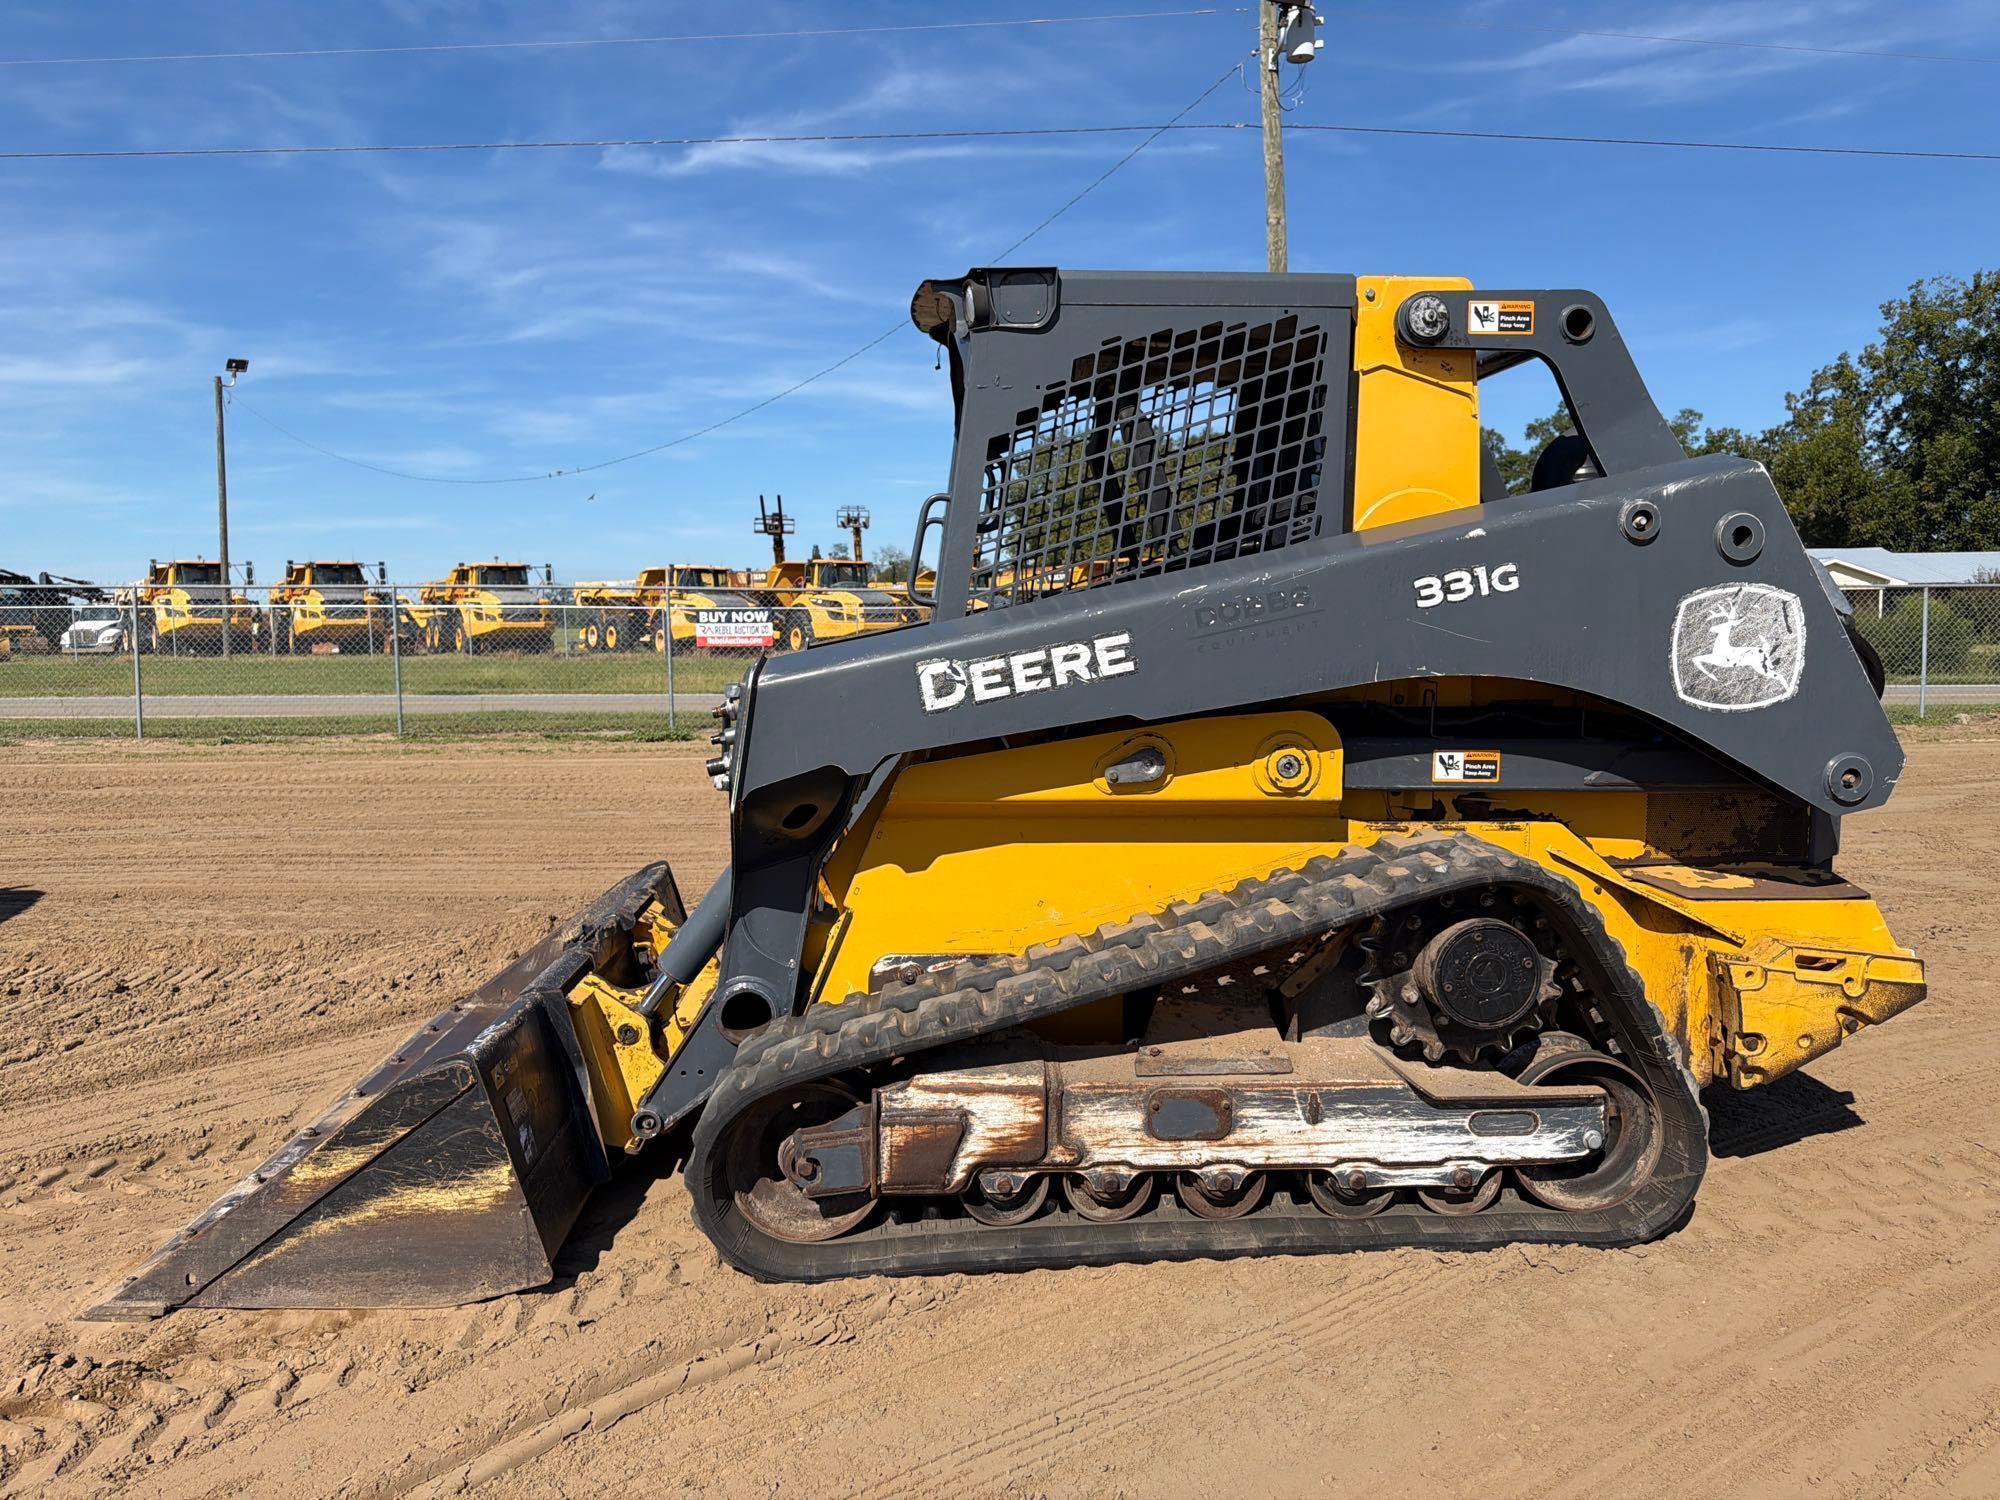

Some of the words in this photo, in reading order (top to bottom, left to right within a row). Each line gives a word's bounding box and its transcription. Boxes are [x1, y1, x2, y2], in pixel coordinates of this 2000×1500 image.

[1413, 564, 1520, 608] 331G
[699, 611, 728, 622] BUY
[731, 611, 769, 622] NOW
[714, 625, 732, 635] REBEL
[734, 625, 759, 635] AUCTION
[918, 633, 1135, 712] DEERE
